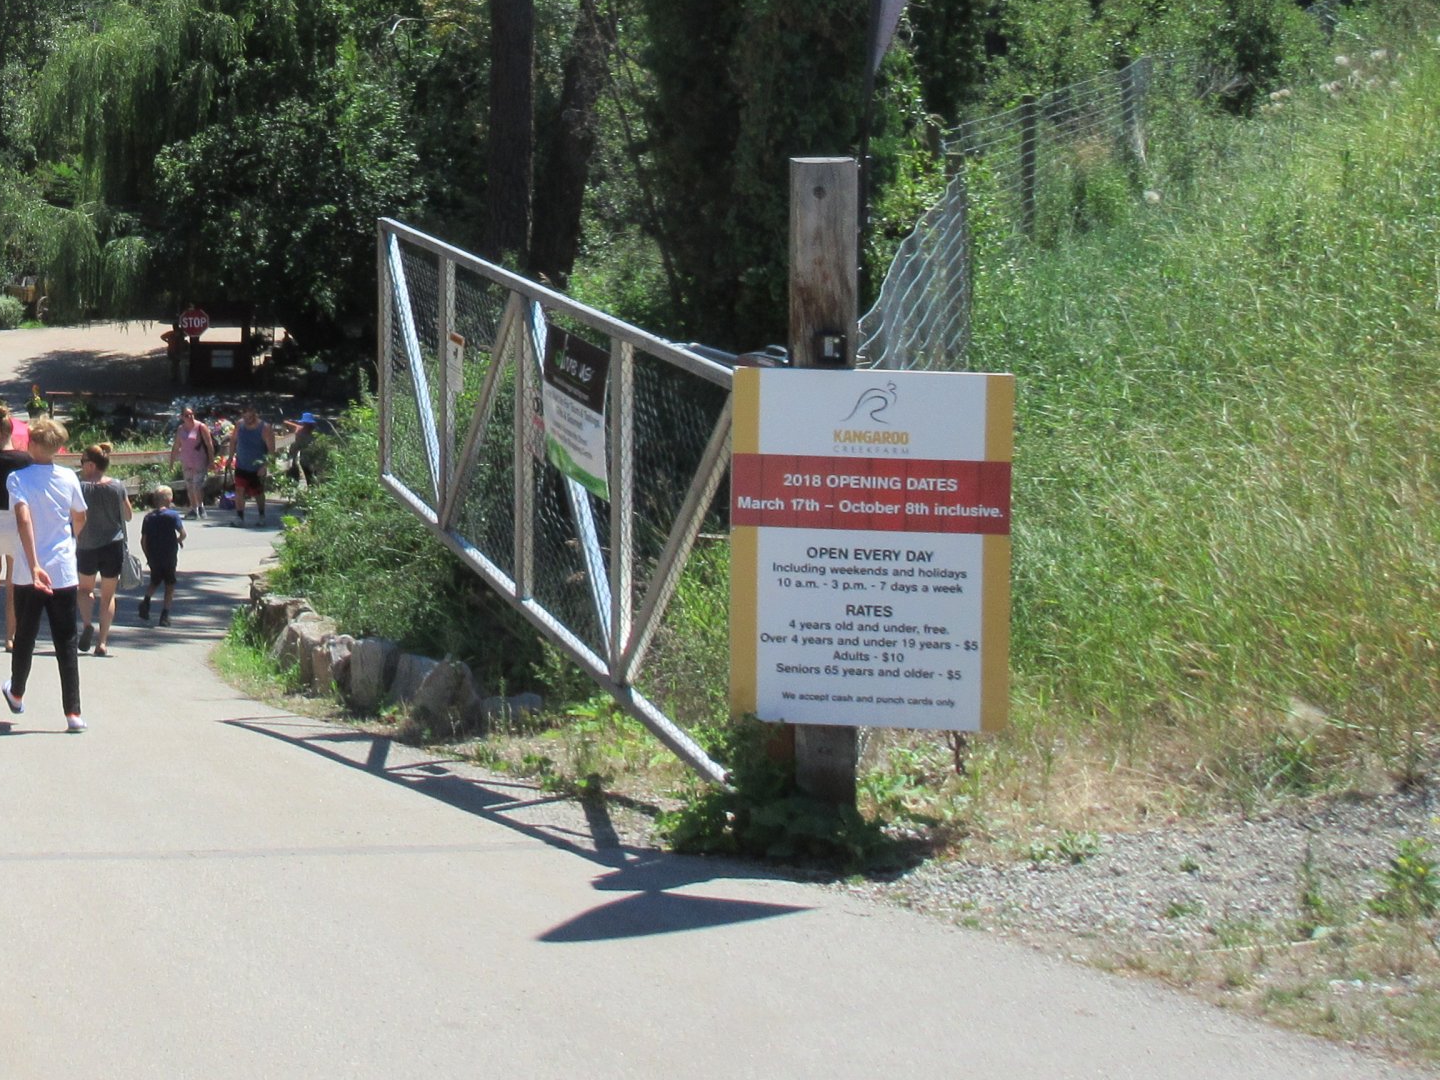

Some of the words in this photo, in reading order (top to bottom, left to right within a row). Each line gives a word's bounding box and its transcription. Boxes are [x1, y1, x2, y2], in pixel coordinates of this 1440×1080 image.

[182, 317, 207, 328] STOP
[832, 429, 910, 445] KANGAROO
[783, 473, 821, 487] 2018
[826, 475, 902, 490] OPENING
[906, 477, 959, 492] DATES
[737, 496, 785, 510] March
[790, 498, 820, 512] 17th
[838, 499, 901, 515] October
[905, 502, 930, 515] 8th
[934, 503, 1004, 518] inclusive.
[806, 546, 849, 559] OPEN
[854, 548, 901, 561] EVERY
[906, 550, 934, 562] DAY
[772, 562, 826, 576] Including
[830, 565, 889, 576] weekends
[892, 567, 915, 577] and
[918, 568, 968, 580] holidays
[777, 577, 792, 588] 10
[795, 580, 820, 589] a.m.
[831, 579, 839, 590] 3
[842, 581, 867, 591] p.m.
[880, 581, 887, 591] 7
[890, 582, 918, 594] days
[921, 584, 929, 593] a
[932, 584, 963, 594] week
[846, 604, 893, 618] RATES
[789, 620, 796, 629] 4
[799, 622, 831, 632] years
[835, 621, 854, 631] old
[857, 622, 879, 632] and
[760, 632, 788, 643] Over
[791, 634, 799, 644] 4
[801, 636, 834, 646] years
[837, 636, 860, 646] and
[863, 637, 898, 648] under
[902, 638, 916, 649] 19
[919, 640, 952, 651] years
[964, 639, 979, 651] $5
[833, 650, 870, 662] Adults
[882, 652, 905, 663] $10
[776, 663, 821, 675] Seniors
[824, 665, 839, 675] 65
[842, 666, 874, 677] years
[878, 667, 900, 678] and
[904, 668, 935, 679] older
[947, 669, 962, 680] $5
[782, 691, 796, 700] We
[799, 693, 829, 702] accept
[832, 694, 853, 702] cash
[856, 695, 874, 704] and
[876, 696, 905, 706] punch
[907, 697, 933, 706] cards
[935, 698, 955, 708] only
